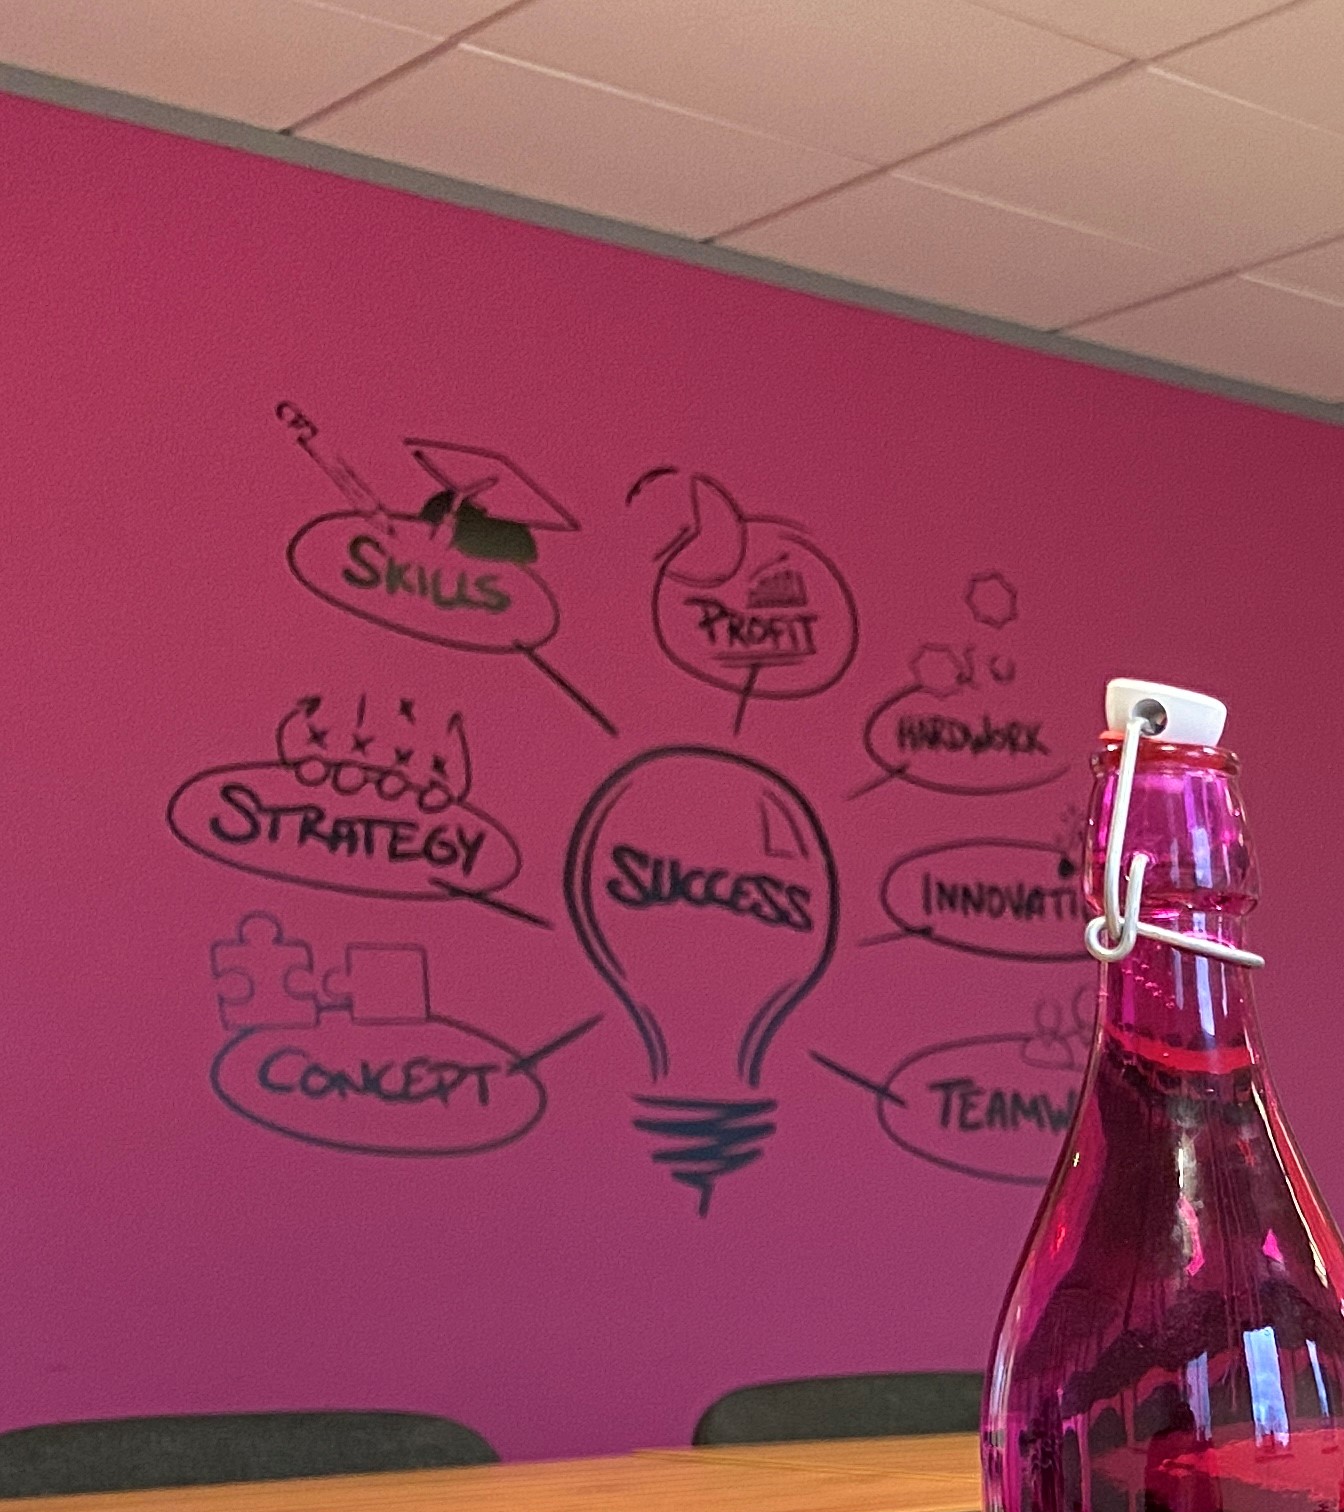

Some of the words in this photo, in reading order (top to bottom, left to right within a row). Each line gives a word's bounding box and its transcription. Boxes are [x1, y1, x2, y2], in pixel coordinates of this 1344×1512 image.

[342, 534, 512, 614] SKILLS
[684, 596, 818, 650] PROFIT
[209, 783, 486, 876] STRATEGY
[606, 843, 813, 932] SUCCESS
[923, 871, 1088, 921] INNOVATI
[258, 1046, 499, 1106] CONCEPT
[929, 1077, 1074, 1134] TEAMW
